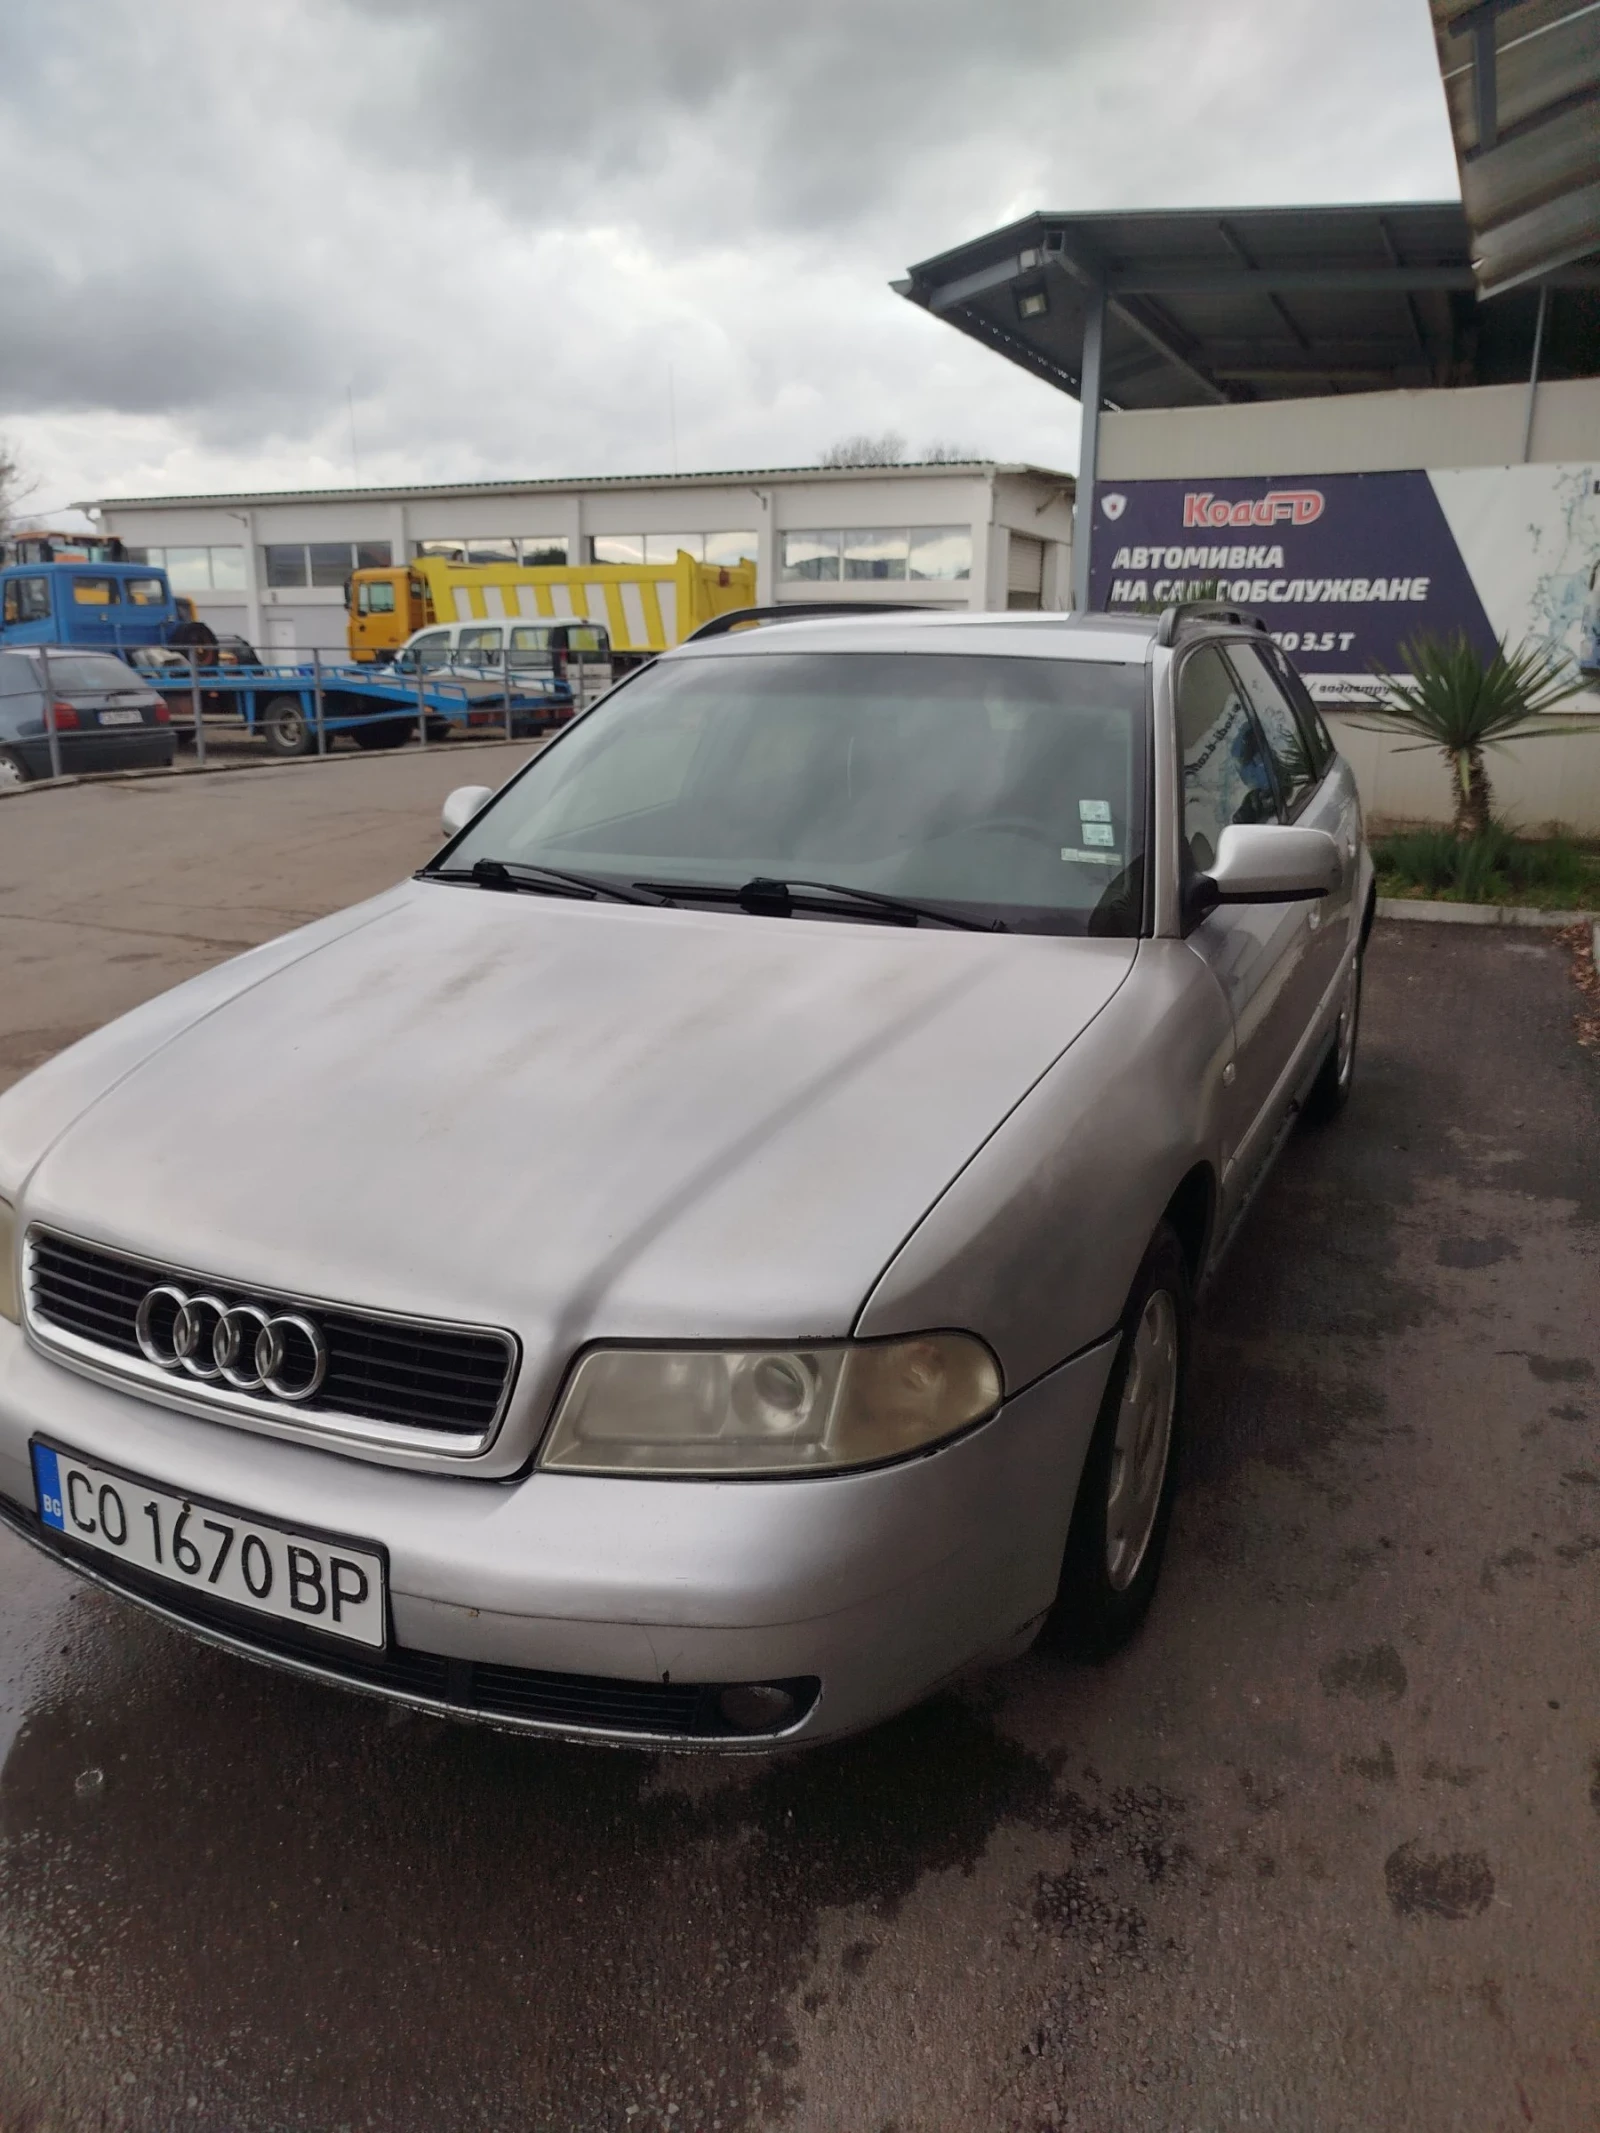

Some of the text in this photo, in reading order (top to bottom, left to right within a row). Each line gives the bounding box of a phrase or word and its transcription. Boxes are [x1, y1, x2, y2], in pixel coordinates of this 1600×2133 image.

[1111, 545, 1285, 570] АВТОМИВКА
[1111, 579, 1147, 602] НА
[1301, 632, 1337, 652] 3.5
[43, 1493, 62, 1517] BG
[66, 1470, 369, 1622] CO 1670 BP
